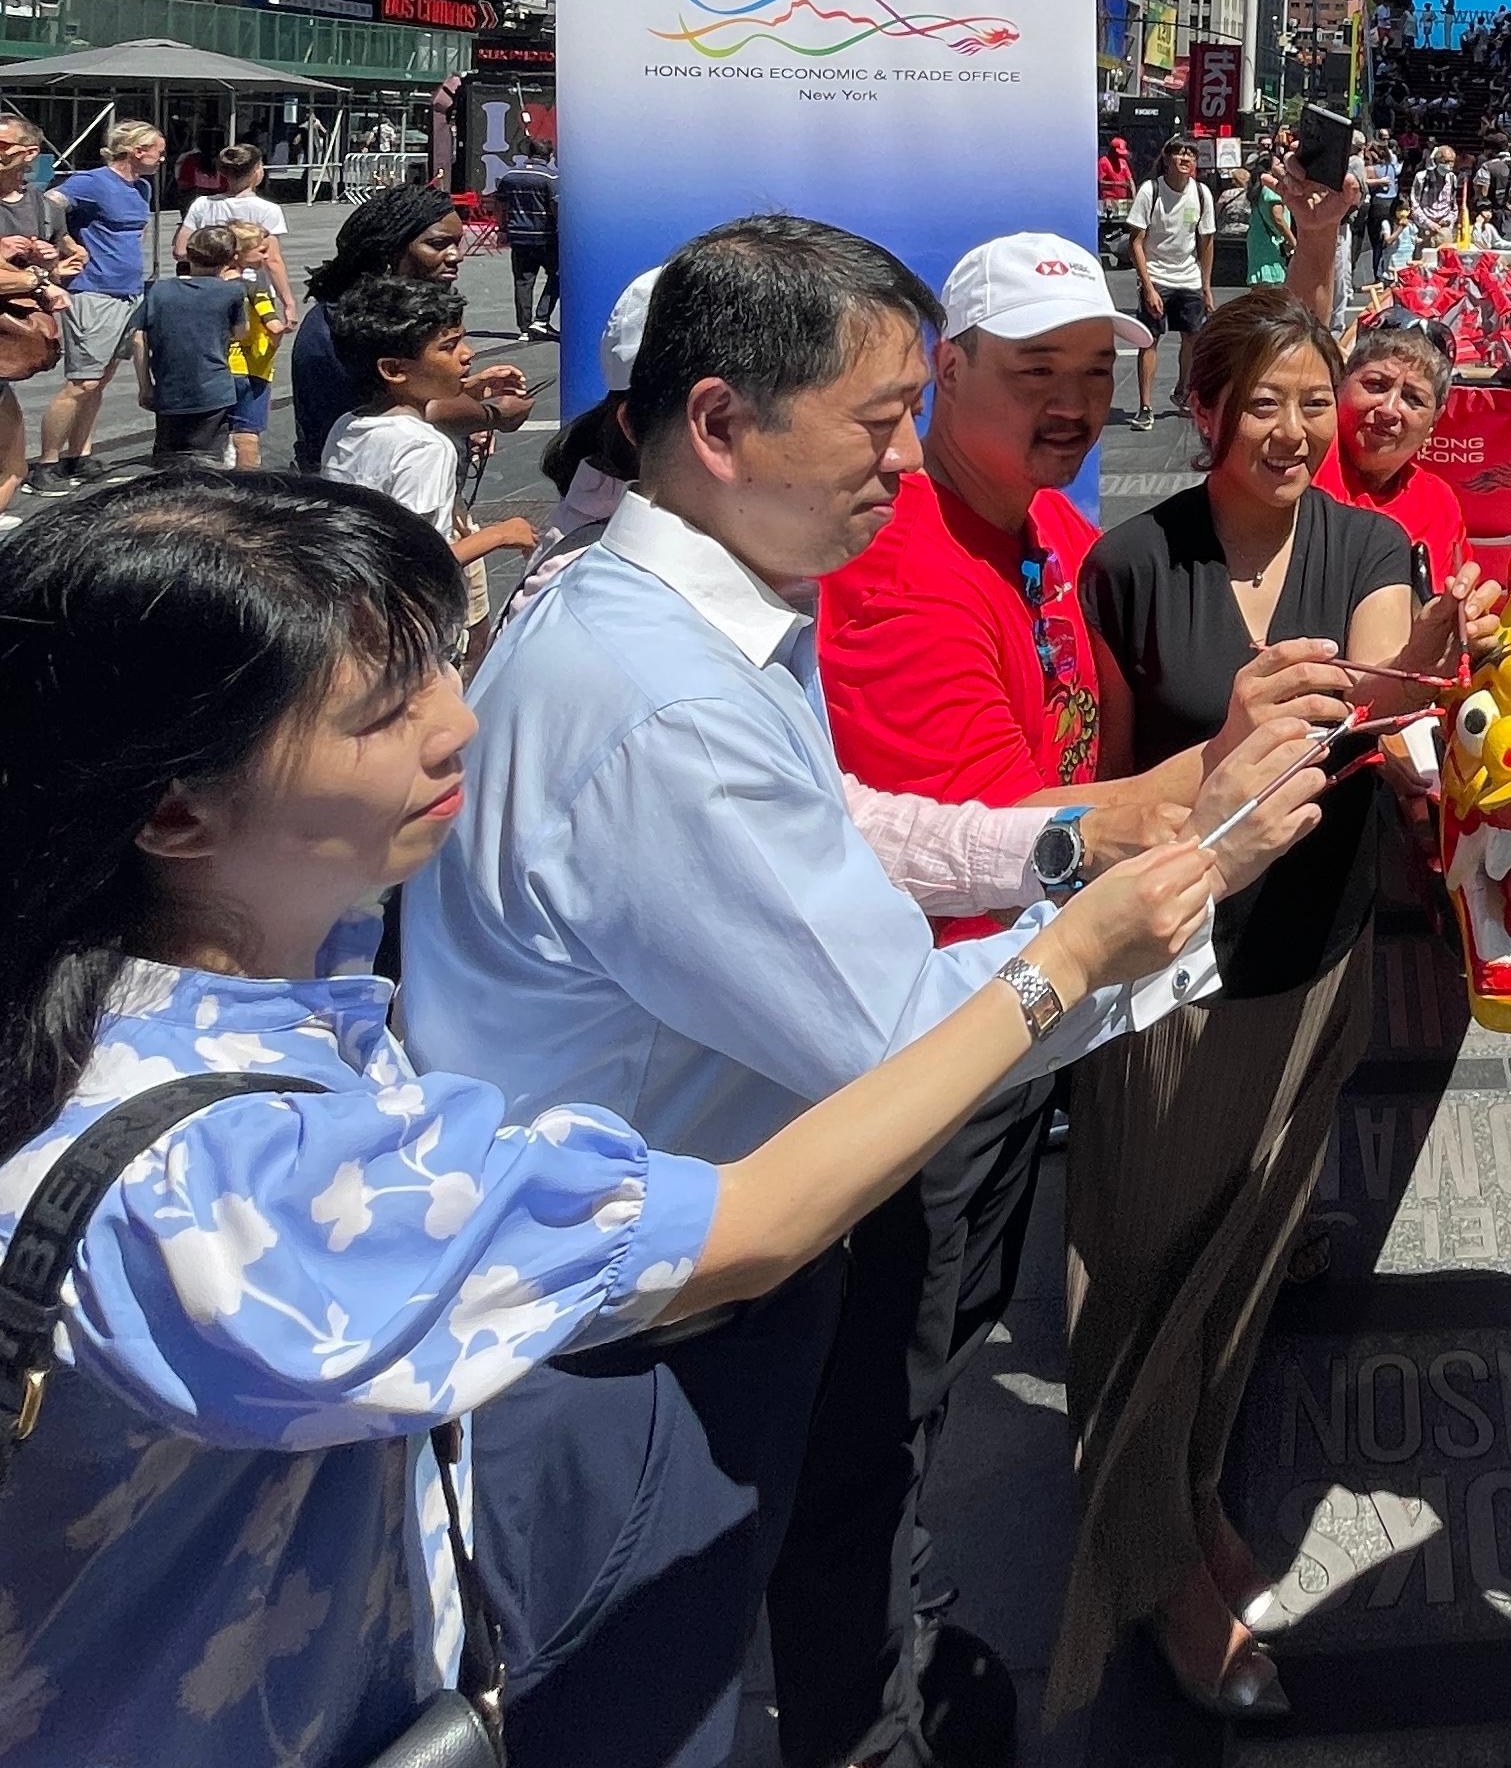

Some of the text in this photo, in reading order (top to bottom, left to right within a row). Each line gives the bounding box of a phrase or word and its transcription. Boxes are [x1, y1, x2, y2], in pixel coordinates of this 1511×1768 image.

[645, 65, 1021, 83] HONG KONG ECONOMIC & TRADE OFFICE
[1201, 49, 1236, 118] tkts
[799, 89, 878, 102] New York
